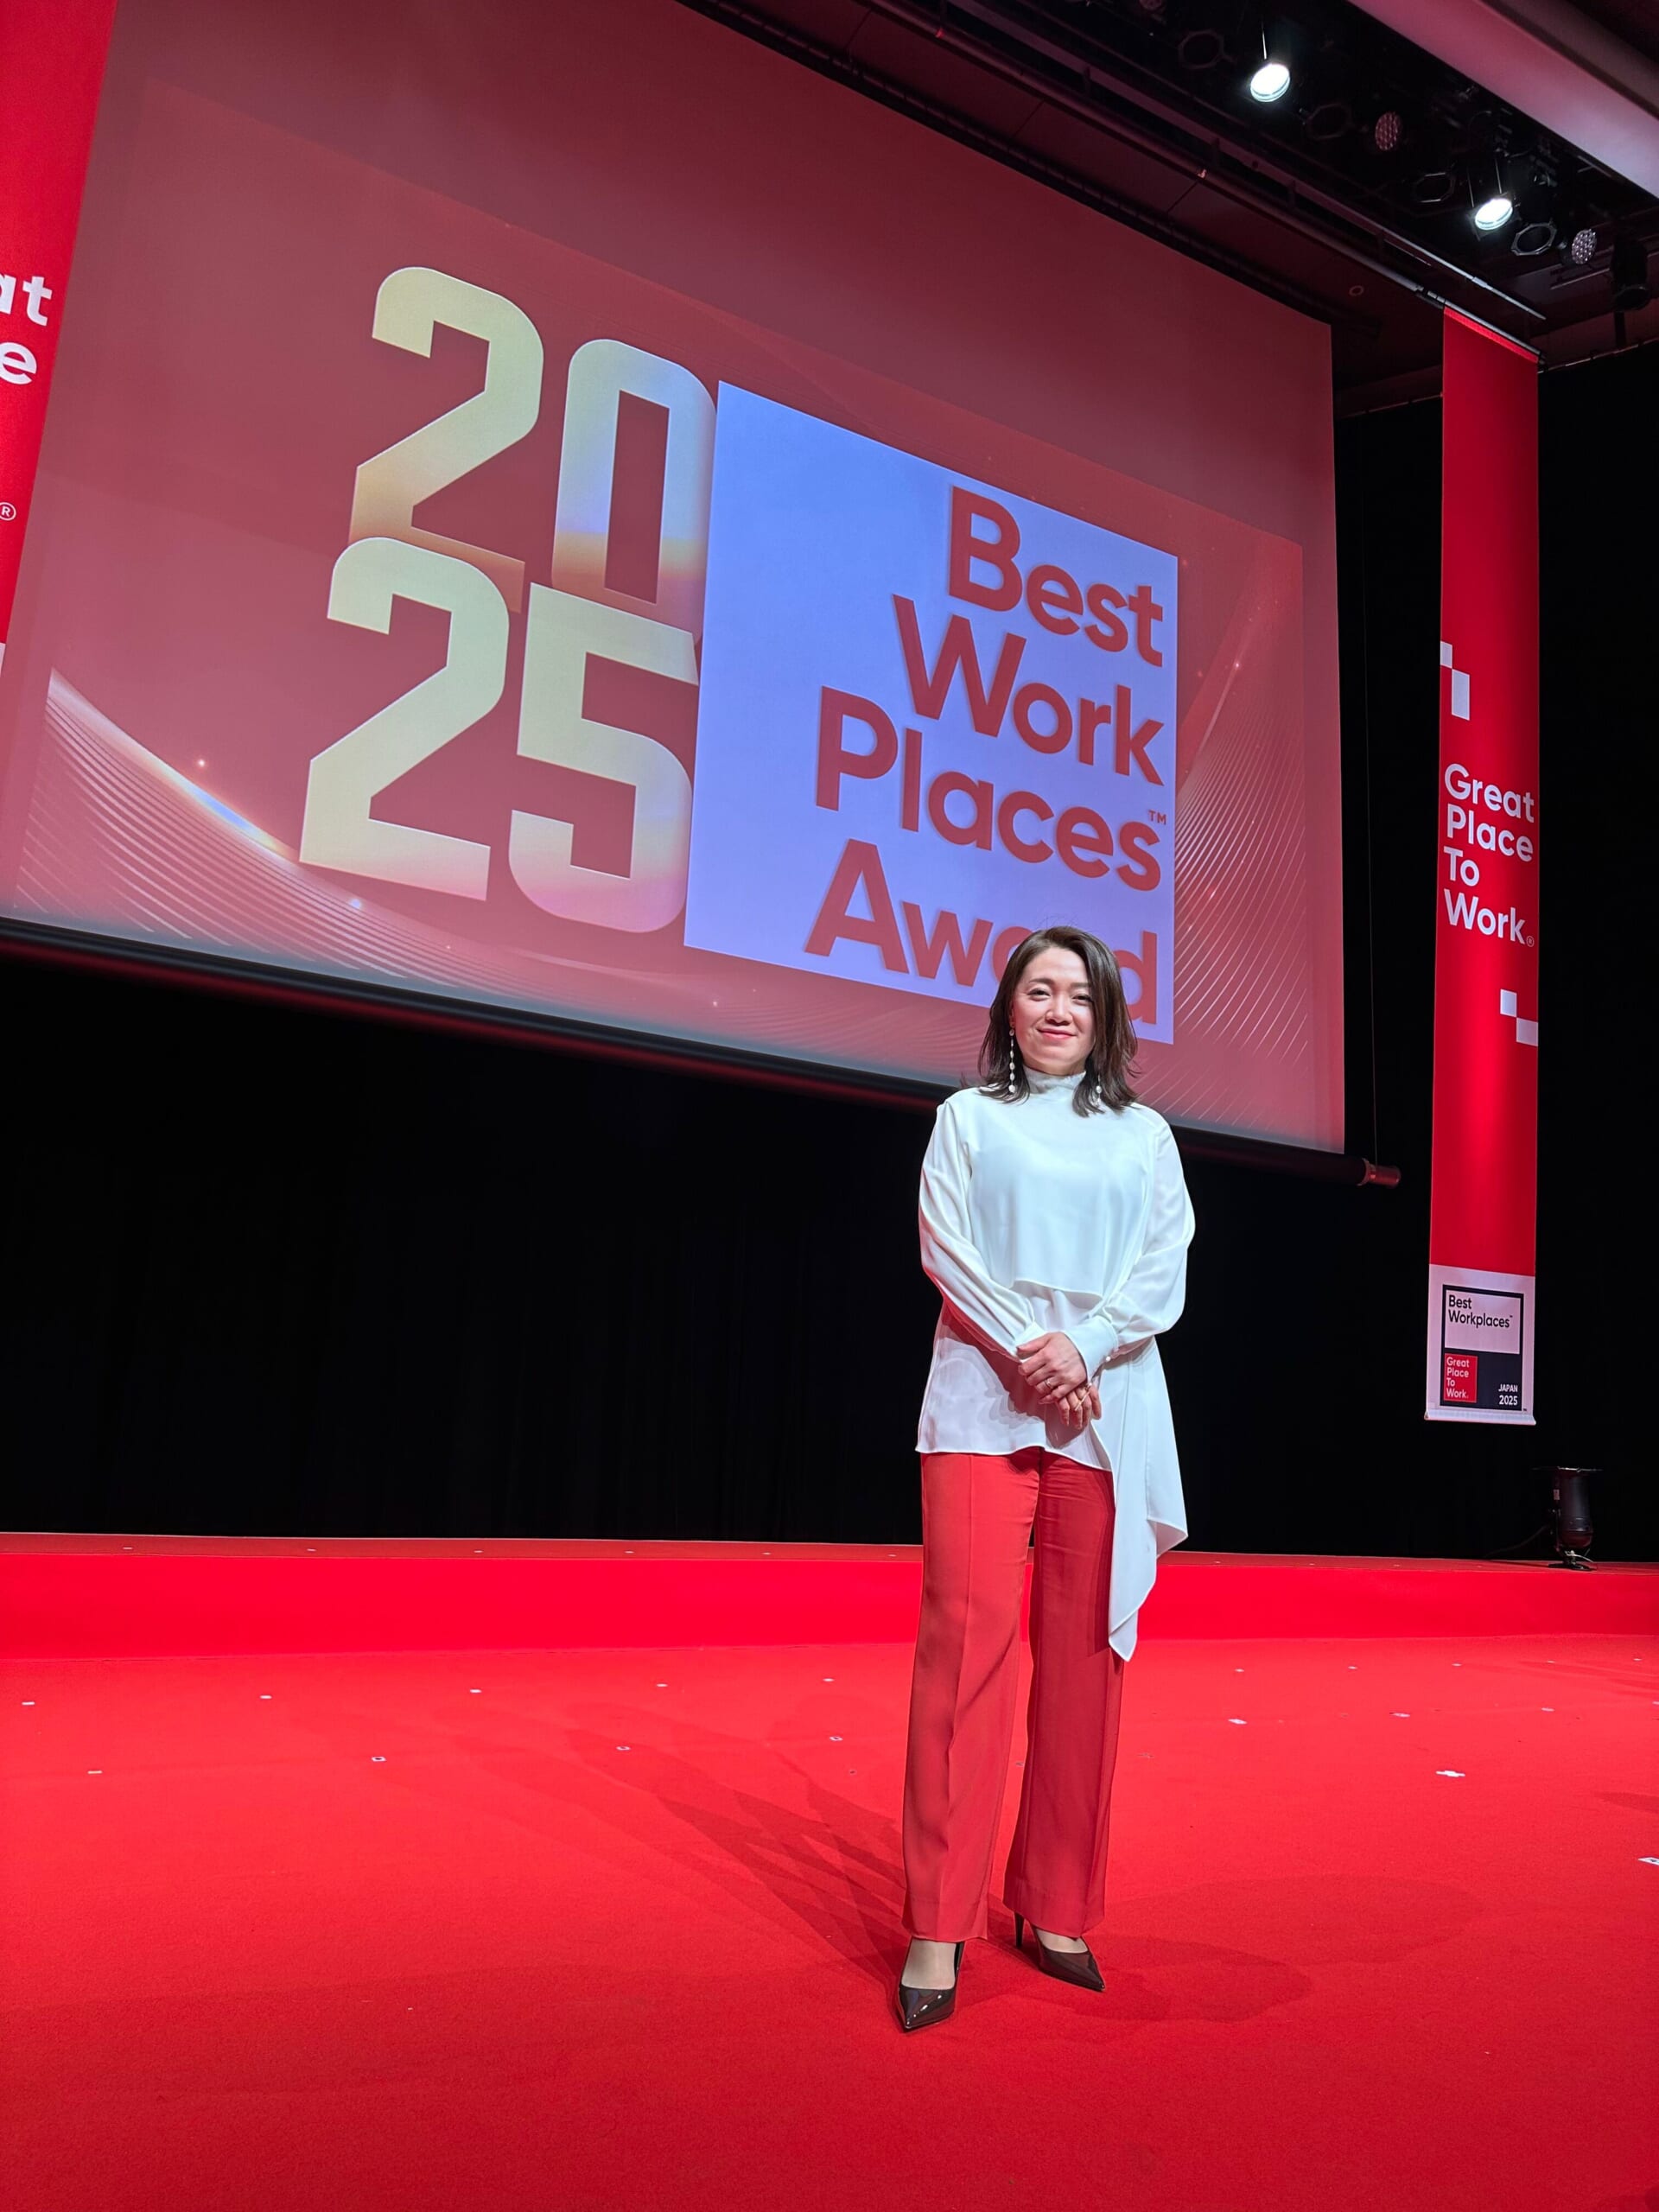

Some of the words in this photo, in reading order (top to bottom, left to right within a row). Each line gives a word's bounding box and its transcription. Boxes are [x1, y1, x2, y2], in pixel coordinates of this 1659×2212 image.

[349, 267, 717, 643] 20
[948, 486, 1164, 667] Best
[893, 594, 1165, 786] Work
[300, 537, 698, 933] 25
[815, 685, 1162, 893] Places
[1444, 763, 1535, 823] Great
[1446, 803, 1535, 863] Place
[1443, 846, 1480, 887] To
[804, 838, 1158, 1026] Awd
[1448, 1294, 1472, 1310] Best
[1448, 1309, 1510, 1329] Workplaces
[1446, 1357, 1470, 1368] Great
[1446, 1367, 1469, 1377] Place
[1446, 1377, 1455, 1387] To
[1498, 1383, 1518, 1393] JAPAN
[1498, 1395, 1518, 1406] 2025
